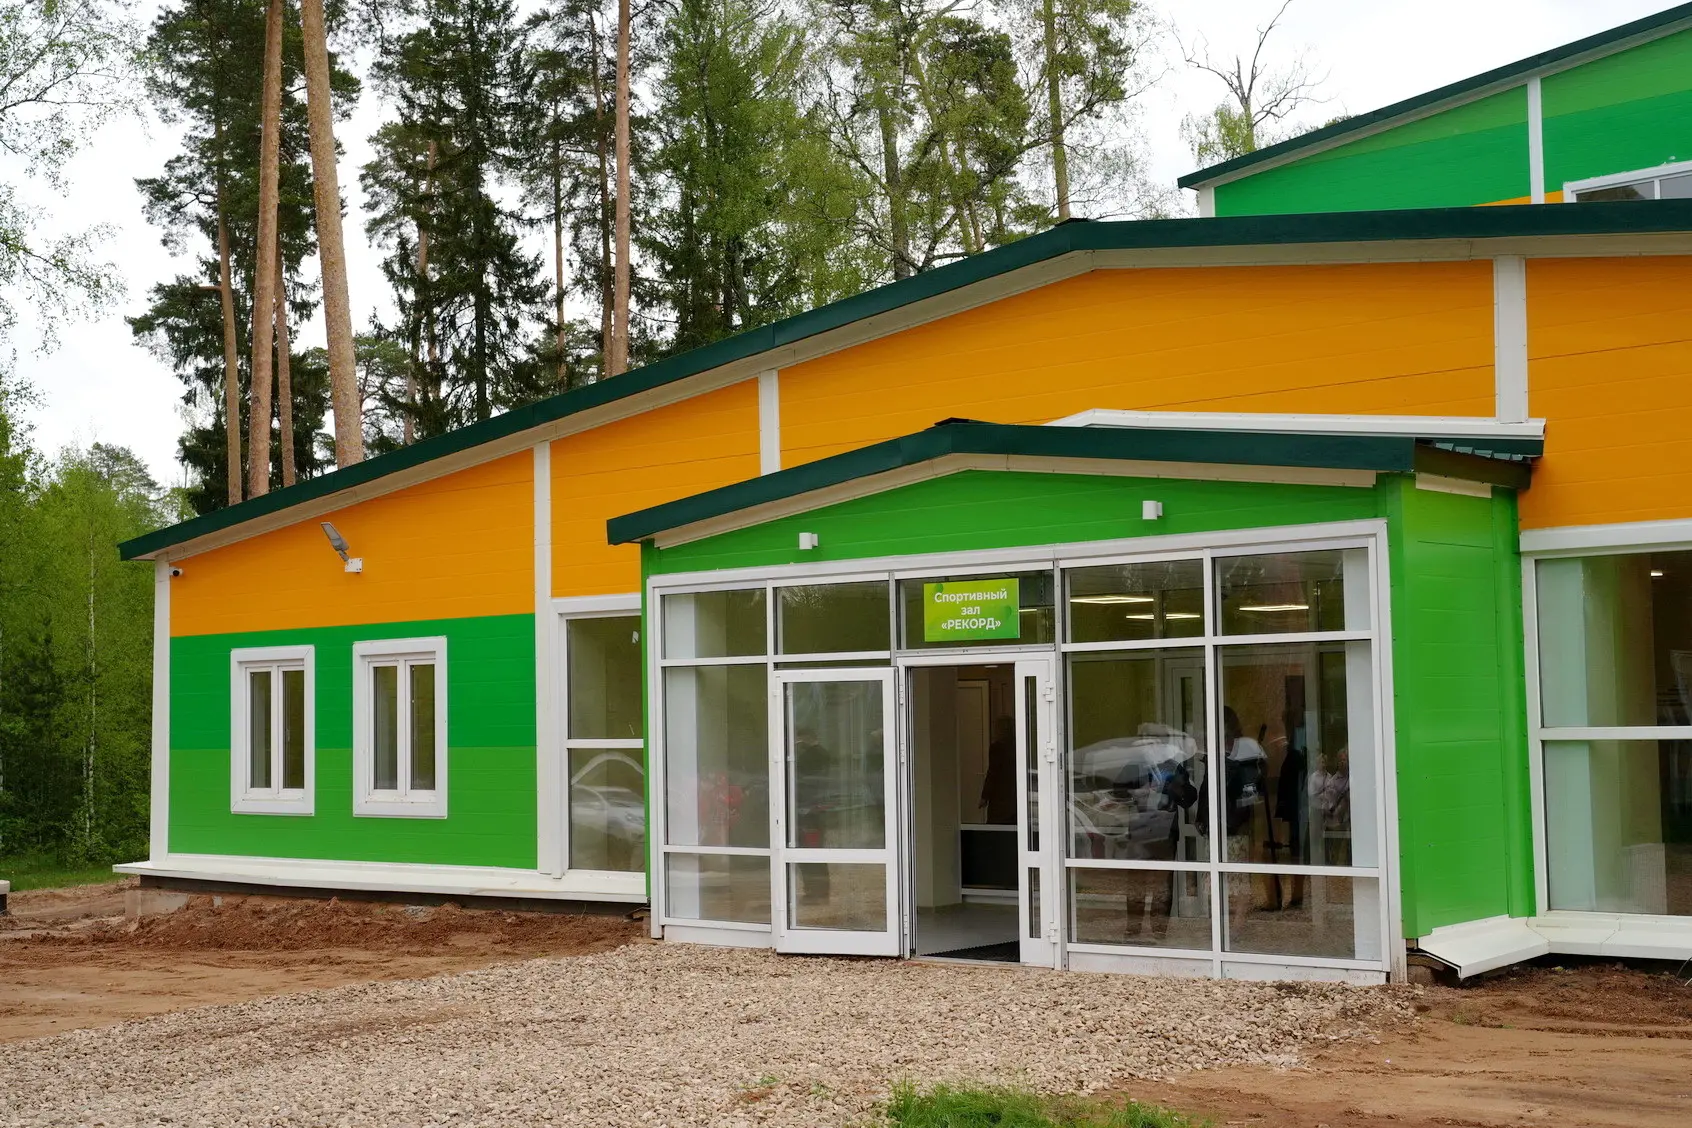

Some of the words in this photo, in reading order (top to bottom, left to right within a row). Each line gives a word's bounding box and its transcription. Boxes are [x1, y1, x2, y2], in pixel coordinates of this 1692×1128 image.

[934, 588, 1007, 604] Спортивный
[961, 606, 981, 615] зал
[941, 617, 1001, 630] «РЕКОРД»
